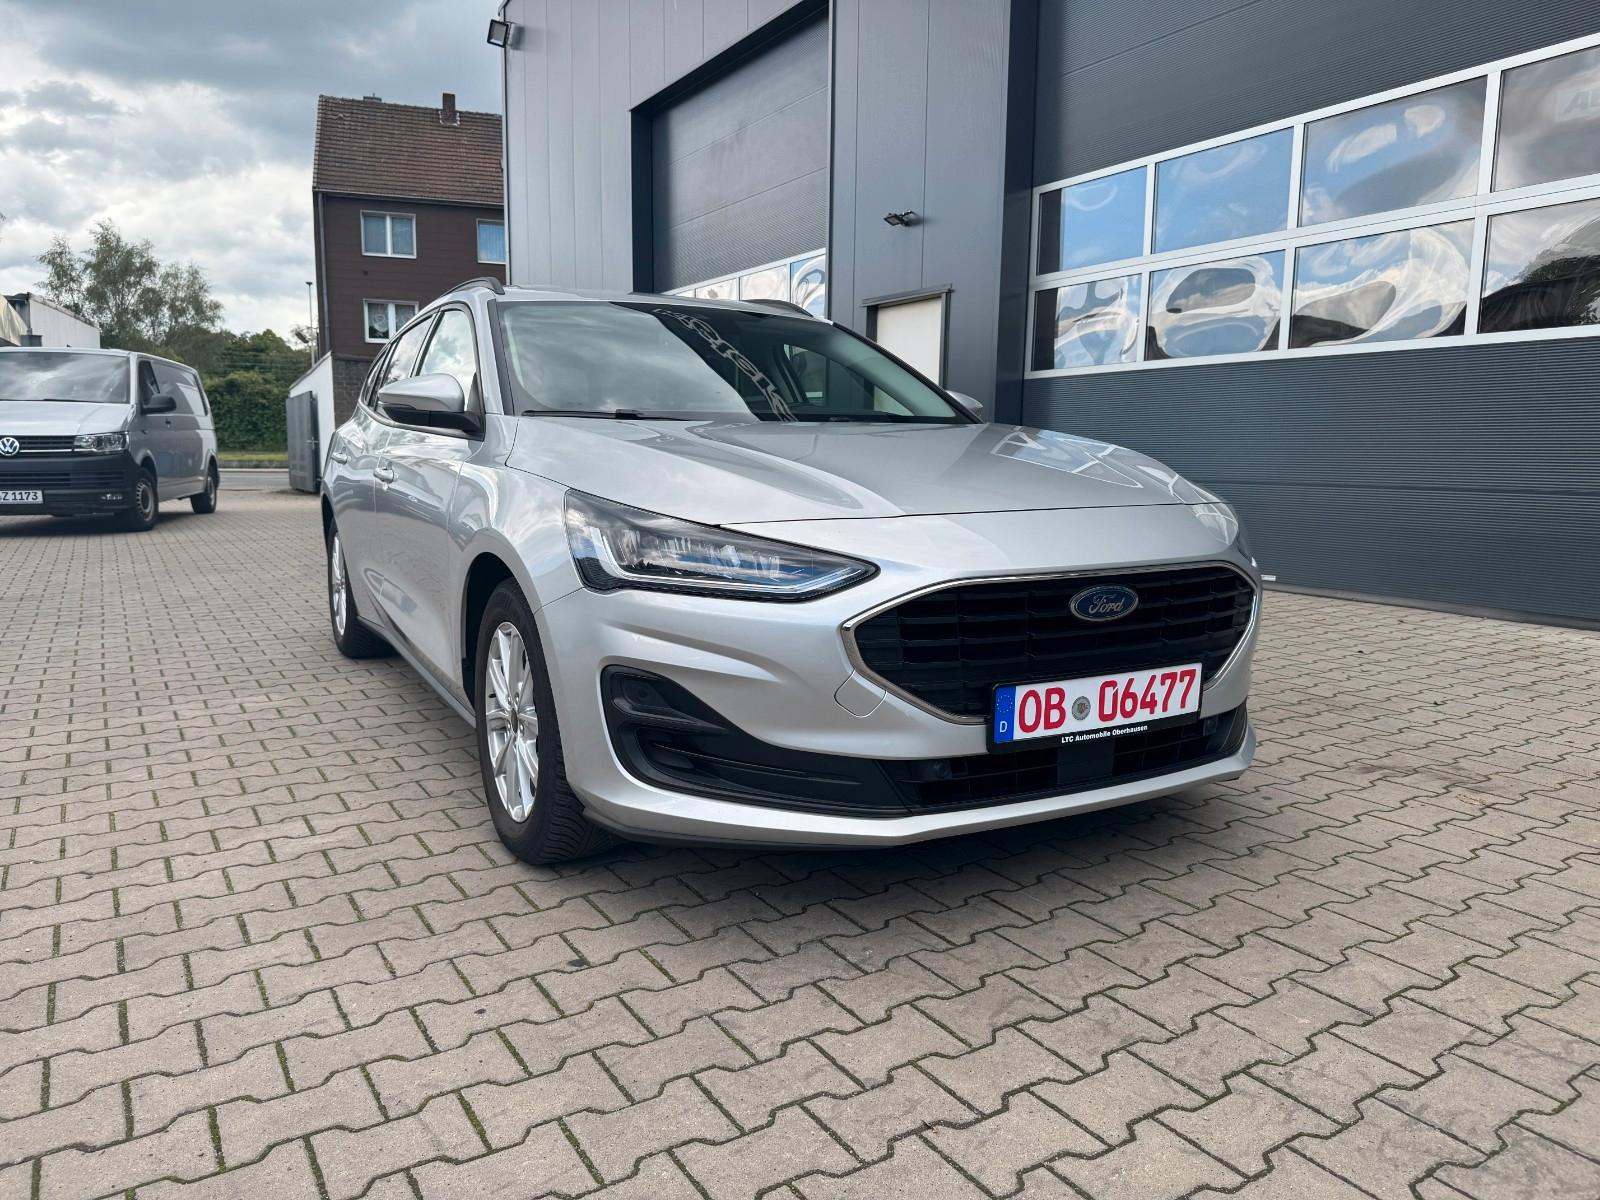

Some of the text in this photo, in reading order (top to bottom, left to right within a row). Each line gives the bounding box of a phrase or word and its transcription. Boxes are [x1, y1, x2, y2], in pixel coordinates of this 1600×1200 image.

[0, 491, 38, 501] Z 1173
[1088, 594, 1126, 614] Ford
[1018, 668, 1197, 734] OB 06477
[1000, 721, 1008, 733] D
[1061, 725, 1148, 744] LTC Automobile Oberhausen
